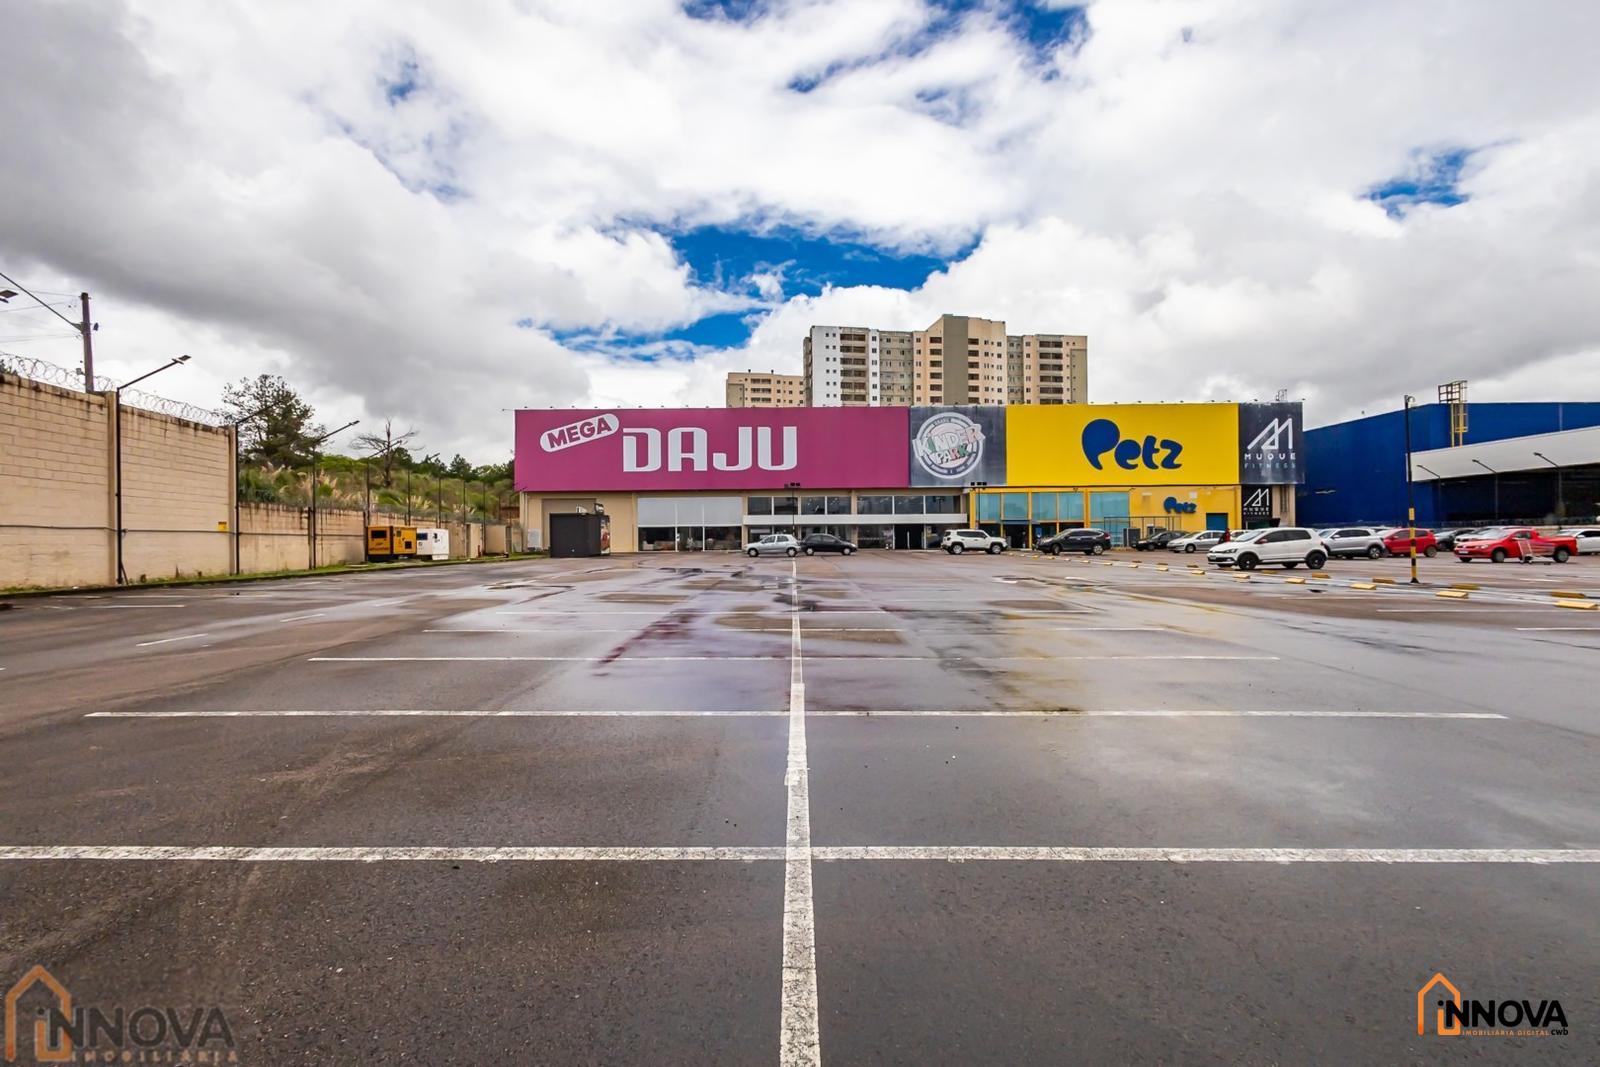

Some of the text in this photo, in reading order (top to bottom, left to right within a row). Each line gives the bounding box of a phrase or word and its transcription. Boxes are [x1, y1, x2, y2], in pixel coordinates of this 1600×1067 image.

[546, 417, 612, 449] MEGA
[913, 424, 985, 457] KINDER
[1081, 418, 1183, 470] Petz
[622, 426, 798, 473] DAJU
[935, 444, 969, 464] PARK
[1163, 496, 1197, 514] Petz
